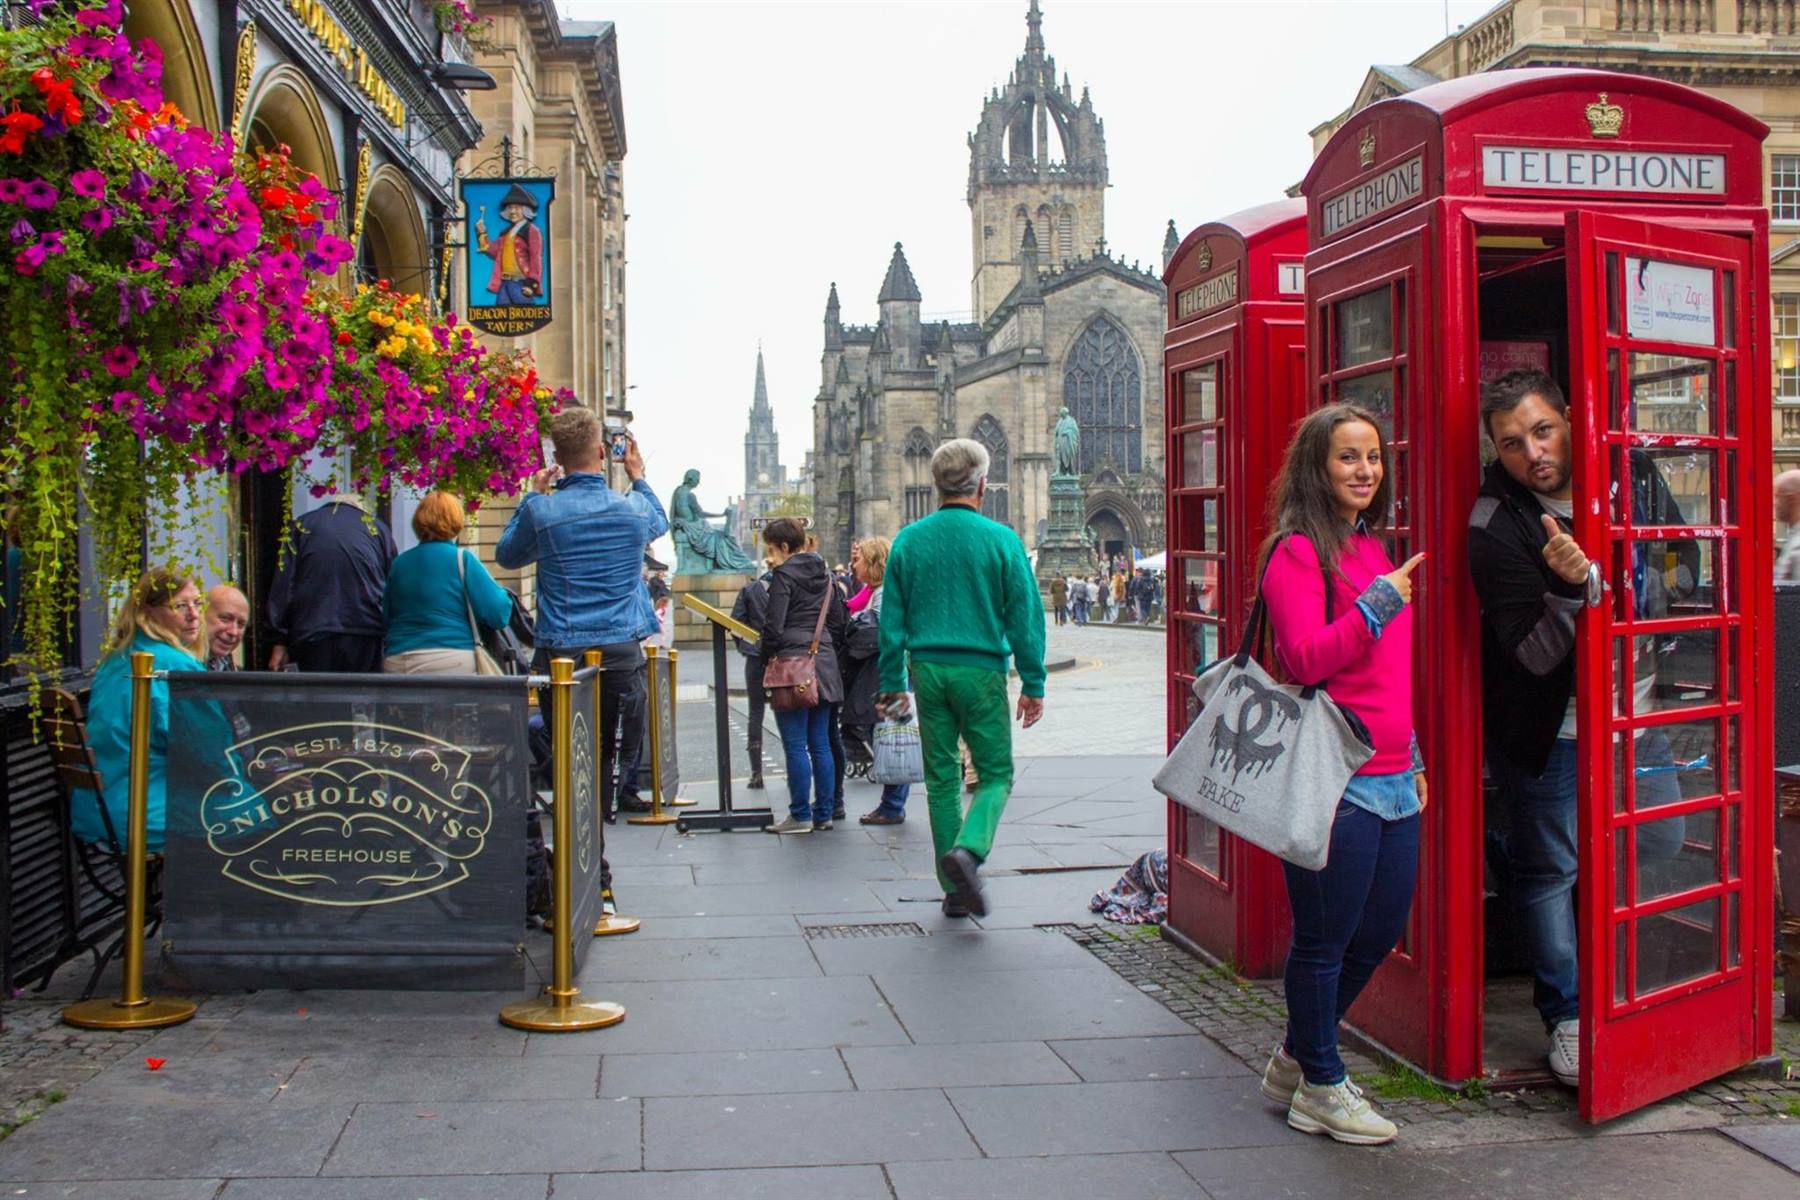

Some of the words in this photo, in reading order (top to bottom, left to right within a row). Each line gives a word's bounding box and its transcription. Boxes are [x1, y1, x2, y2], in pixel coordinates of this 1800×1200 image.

[1492, 150, 1714, 189] TELEPHONE
[1326, 160, 1420, 232] TELEPHONE
[1179, 272, 1237, 316] TELEPHONE
[468, 308, 507, 320] DEACON
[509, 307, 550, 319] BRODIE'S
[485, 321, 534, 333] TAVERN
[294, 737, 342, 757] EST.
[352, 738, 403, 758] 1873
[230, 786, 463, 839] NICHOLSON'S
[1197, 776, 1246, 813] FAKE
[282, 849, 412, 864] FREEHOUSE
